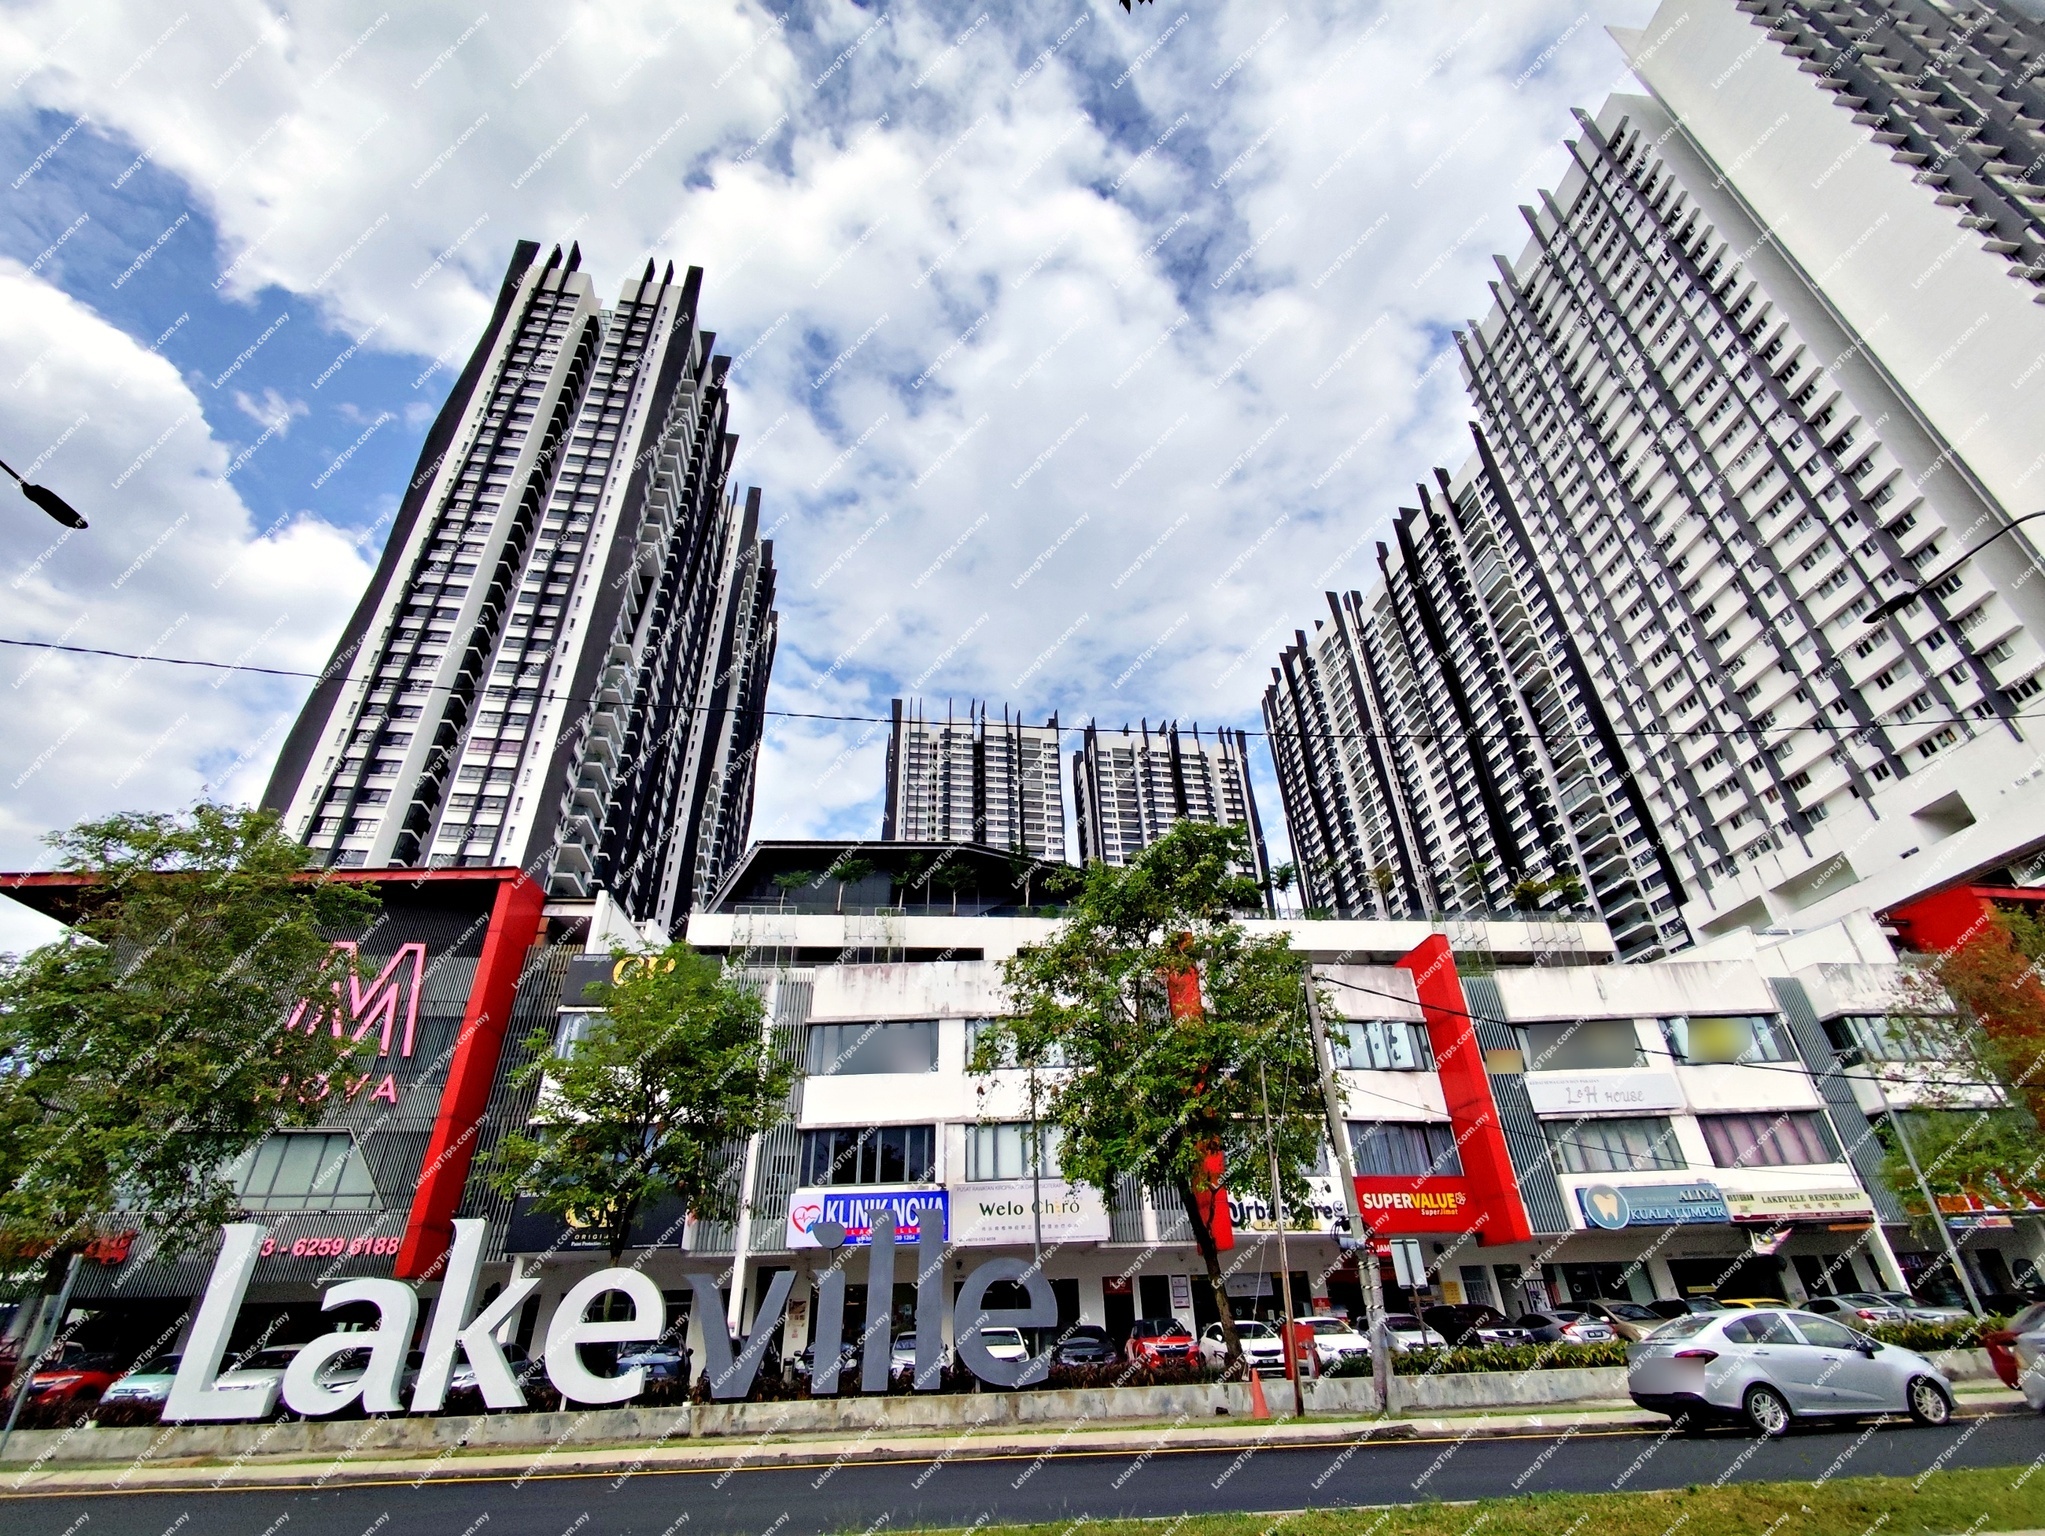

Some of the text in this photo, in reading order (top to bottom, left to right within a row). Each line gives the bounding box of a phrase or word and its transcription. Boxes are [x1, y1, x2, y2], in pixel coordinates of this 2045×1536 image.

[1362, 1193, 1457, 1209] SUPERVALUE
[1679, 1188, 1719, 1202] ALIYA
[1761, 1194, 1807, 1204] LAKEVILLE
[1808, 1192, 1861, 1202] RESTAURANT
[979, 1200, 1024, 1216] Welo
[1630, 1206, 1727, 1221] KUALA LUMPUR
[293, 1237, 346, 1256] 6259
[350, 1236, 400, 1256] 6188
